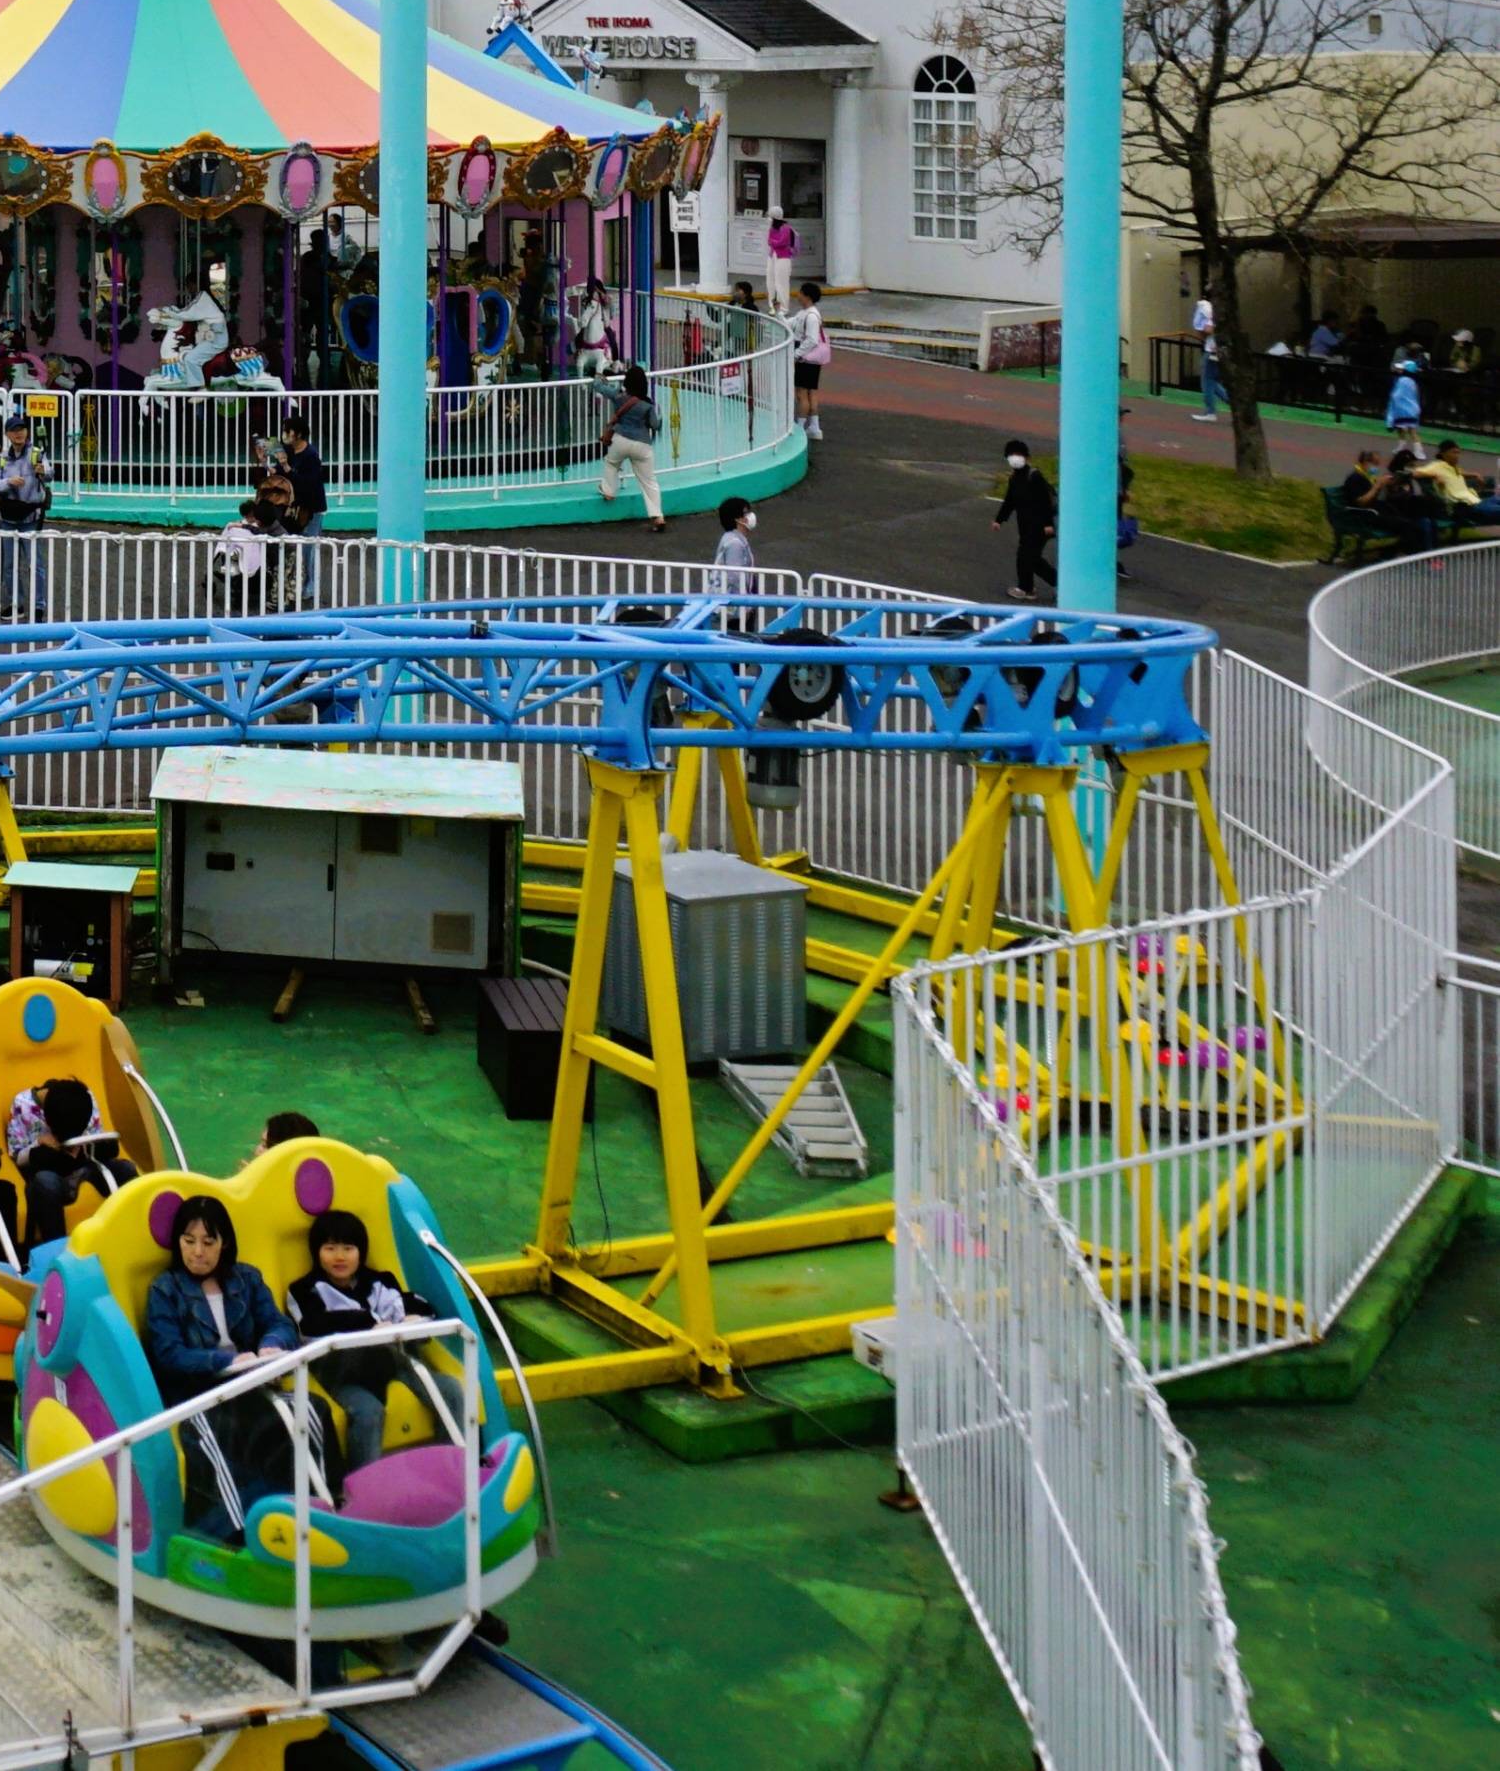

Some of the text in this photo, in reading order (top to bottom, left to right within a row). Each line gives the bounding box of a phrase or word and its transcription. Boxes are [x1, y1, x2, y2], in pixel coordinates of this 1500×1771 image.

[586, 17, 652, 28] THE IKOMA
[30, 401, 55, 411] 非常口
